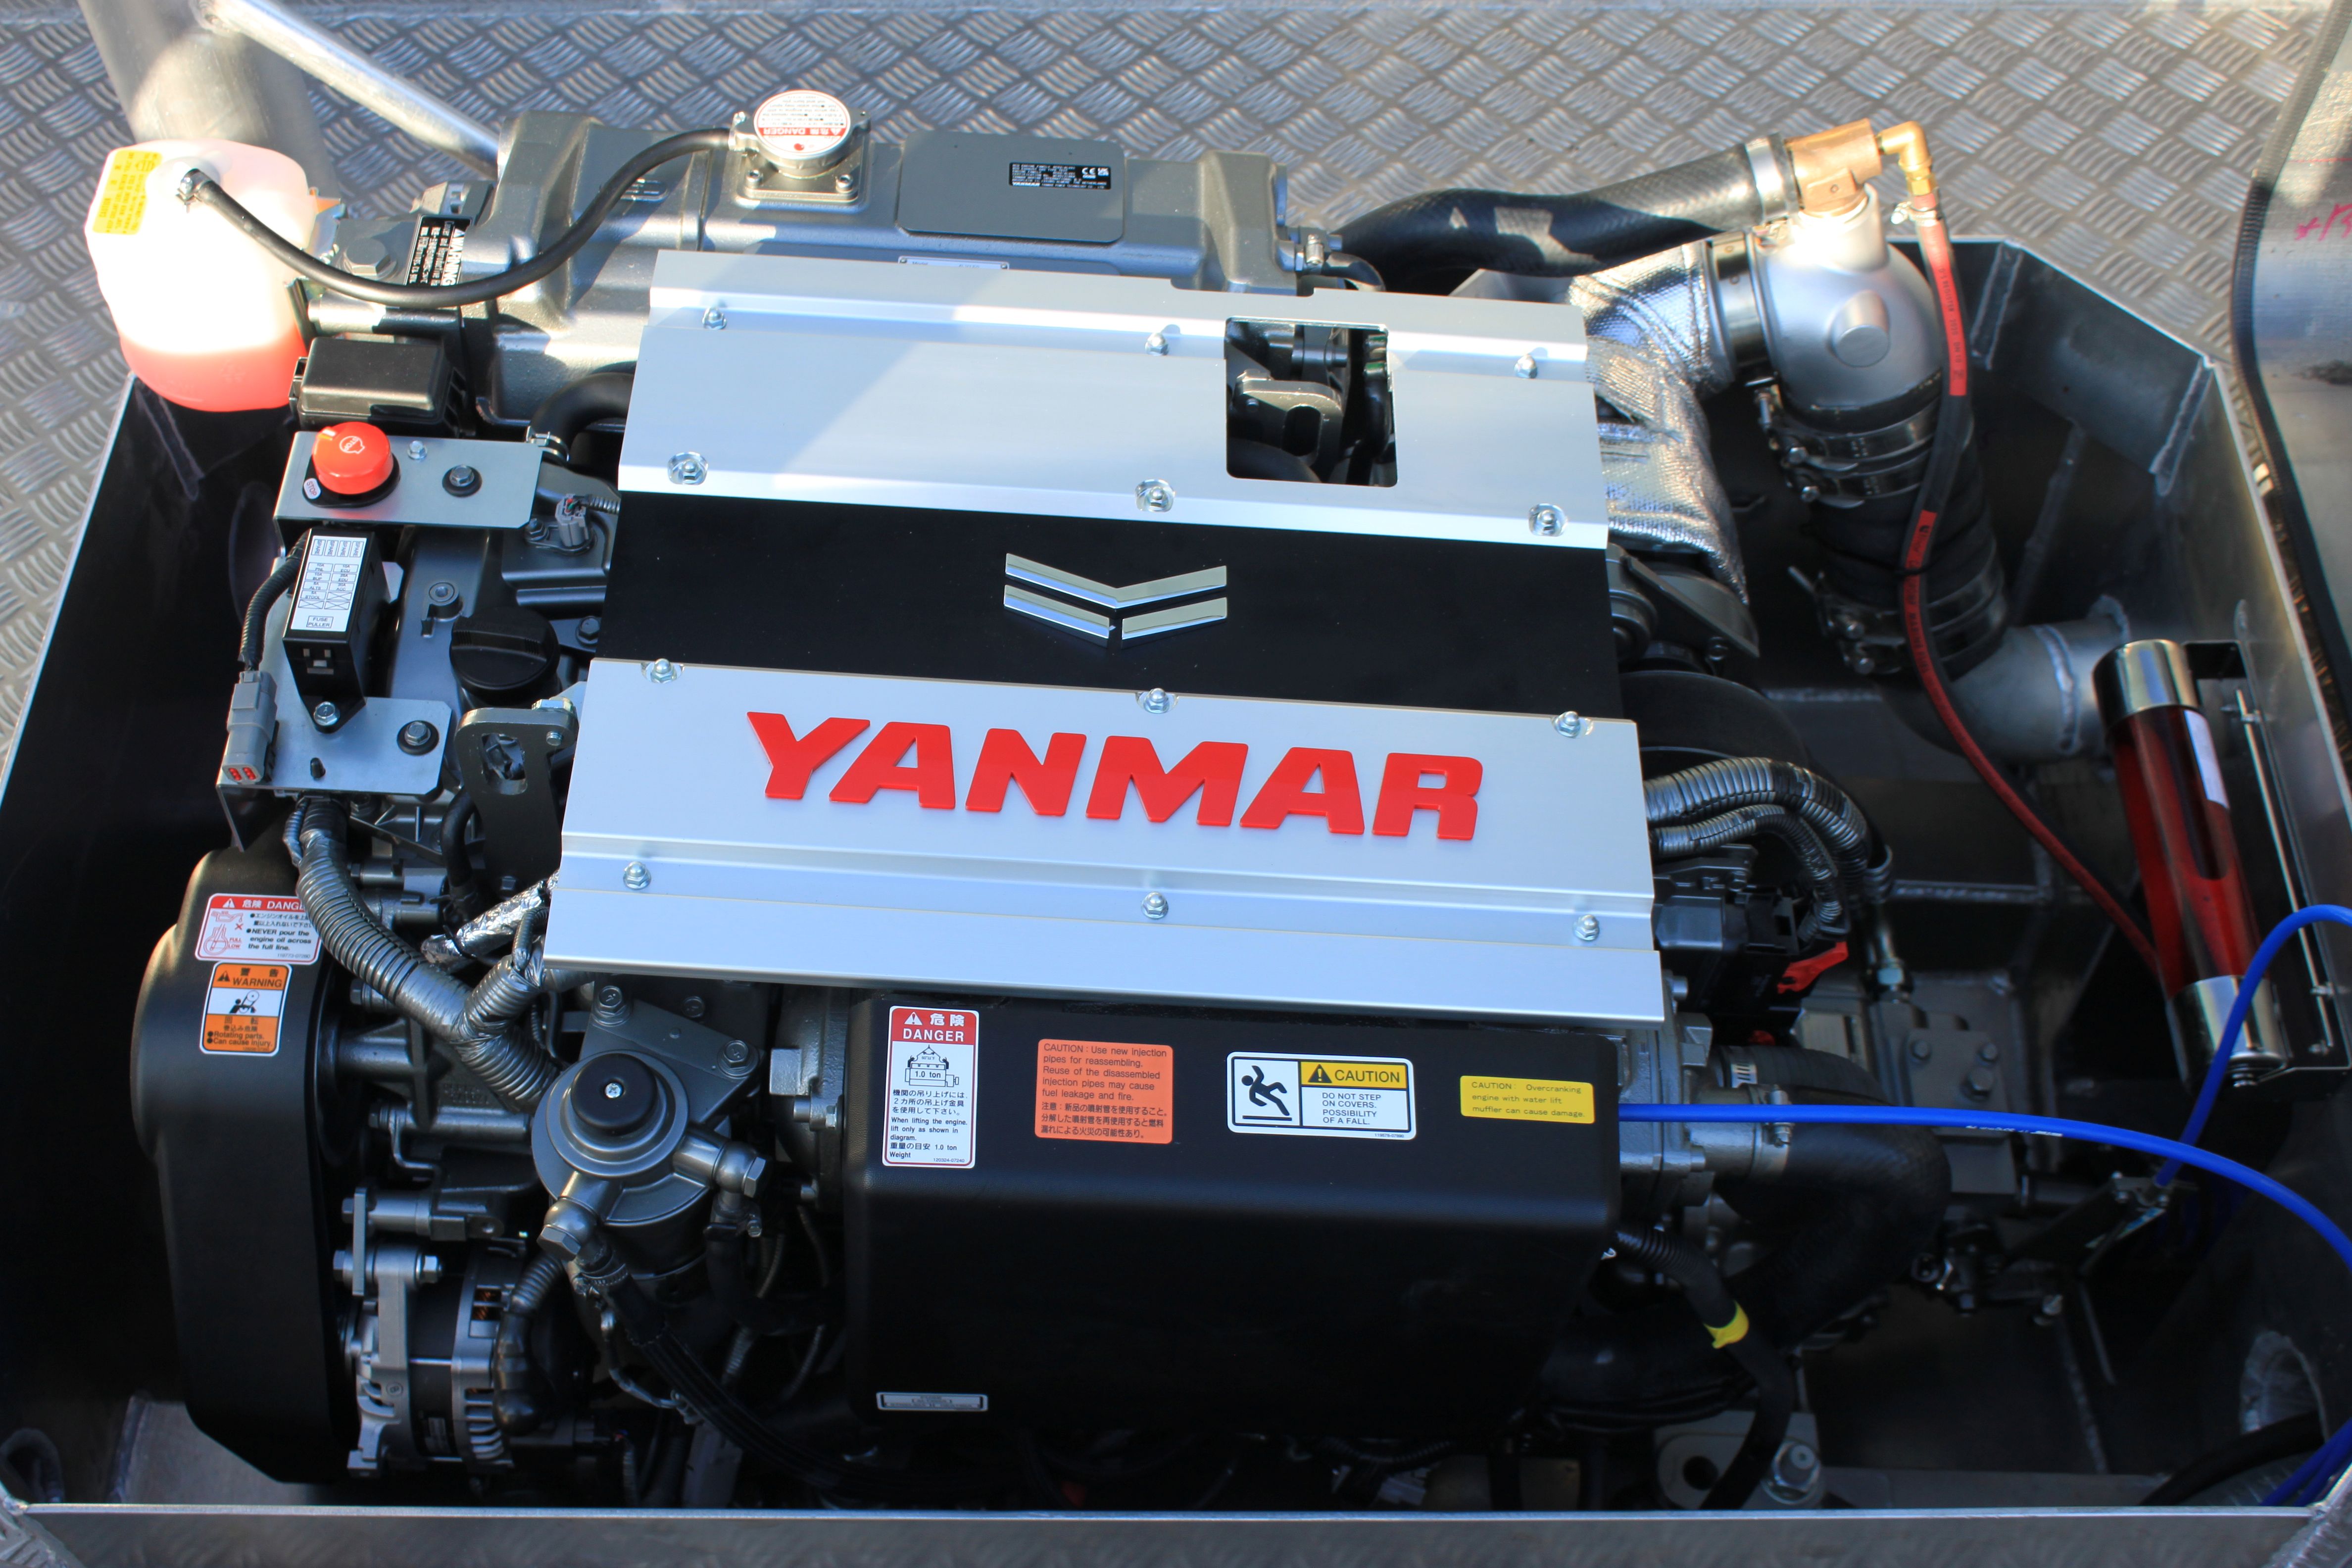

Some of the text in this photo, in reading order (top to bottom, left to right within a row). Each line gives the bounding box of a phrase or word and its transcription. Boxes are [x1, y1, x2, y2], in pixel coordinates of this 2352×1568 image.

[441, 237, 464, 286] WARNING
[307, 481, 317, 496] STOP
[746, 711, 1483, 841] YANMAR
[243, 899, 304, 910] 危険 DANG
[233, 978, 282, 987] WARNING
[930, 1013, 965, 1027] 危険
[903, 1028, 964, 1042] DANGER
[1044, 1043, 1083, 1053] CAUTION
[1132, 1048, 1167, 1057] injection
[1043, 1055, 1066, 1064] pipes
[1085, 1058, 1143, 1068] reassembling.
[1043, 1066, 1070, 1075] Reuse
[1103, 1070, 1160, 1079] disassembled
[1335, 1070, 1400, 1083] CAUTION
[1043, 1078, 1078, 1086] injection
[1082, 1079, 1105, 1088] pipes
[1526, 1084, 1581, 1094] Overcranking
[1062, 1089, 1094, 1100] leakage
[1118, 1092, 1134, 1101] fire.
[892, 1106, 960, 1116] を使用して下さい。
